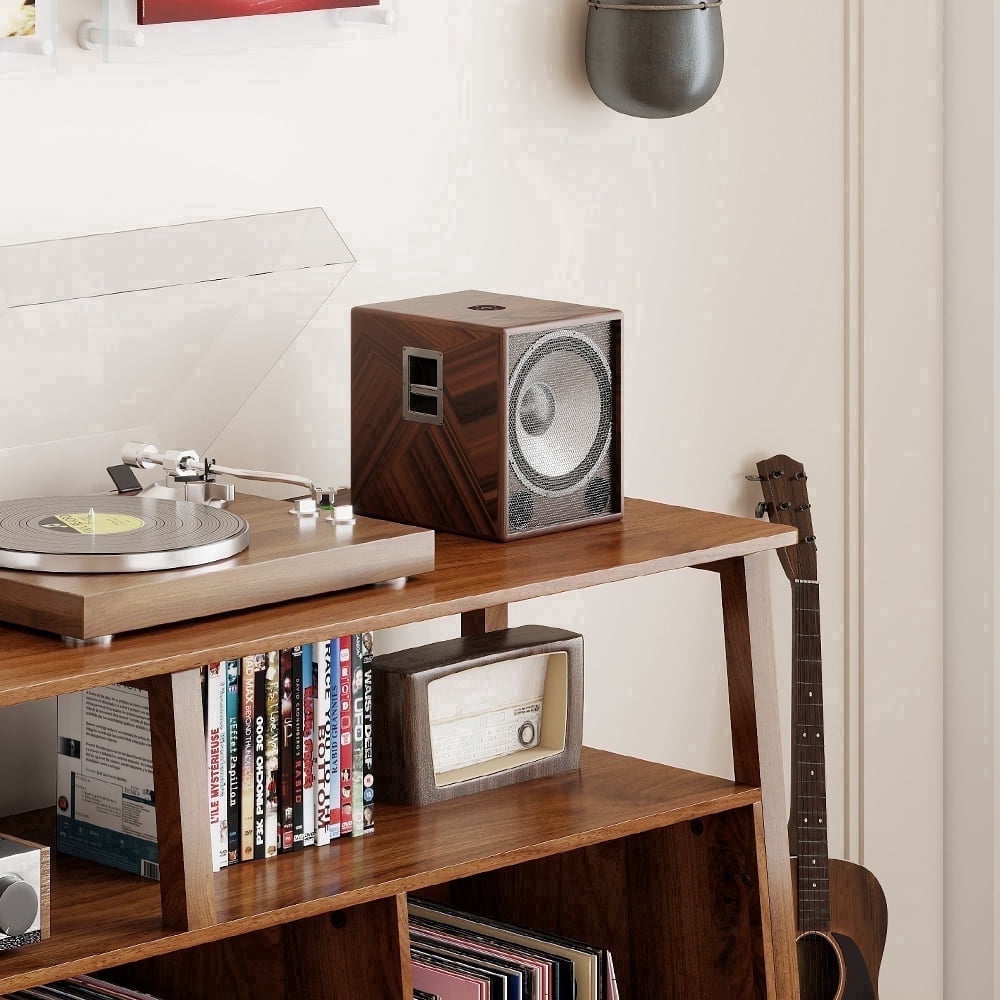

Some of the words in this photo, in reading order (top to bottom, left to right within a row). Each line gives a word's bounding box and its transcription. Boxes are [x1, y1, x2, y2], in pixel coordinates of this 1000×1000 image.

[246, 678, 254, 704] MAX
[324, 644, 332, 700] RACE
[363, 669, 372, 722] WAIST
[255, 716, 264, 753] 3000
[269, 710, 279, 733] Love
[354, 696, 364, 742] UFO
[209, 728, 220, 799] MYSTÉRIEUSE
[363, 725, 373, 770] DEEP
[228, 757, 238, 807] Papillon
[255, 756, 264, 816] PINOCHO
[317, 725, 326, 830] BOTTOM
[210, 801, 219, 825] L'ILE
[255, 819, 264, 845] P3K
